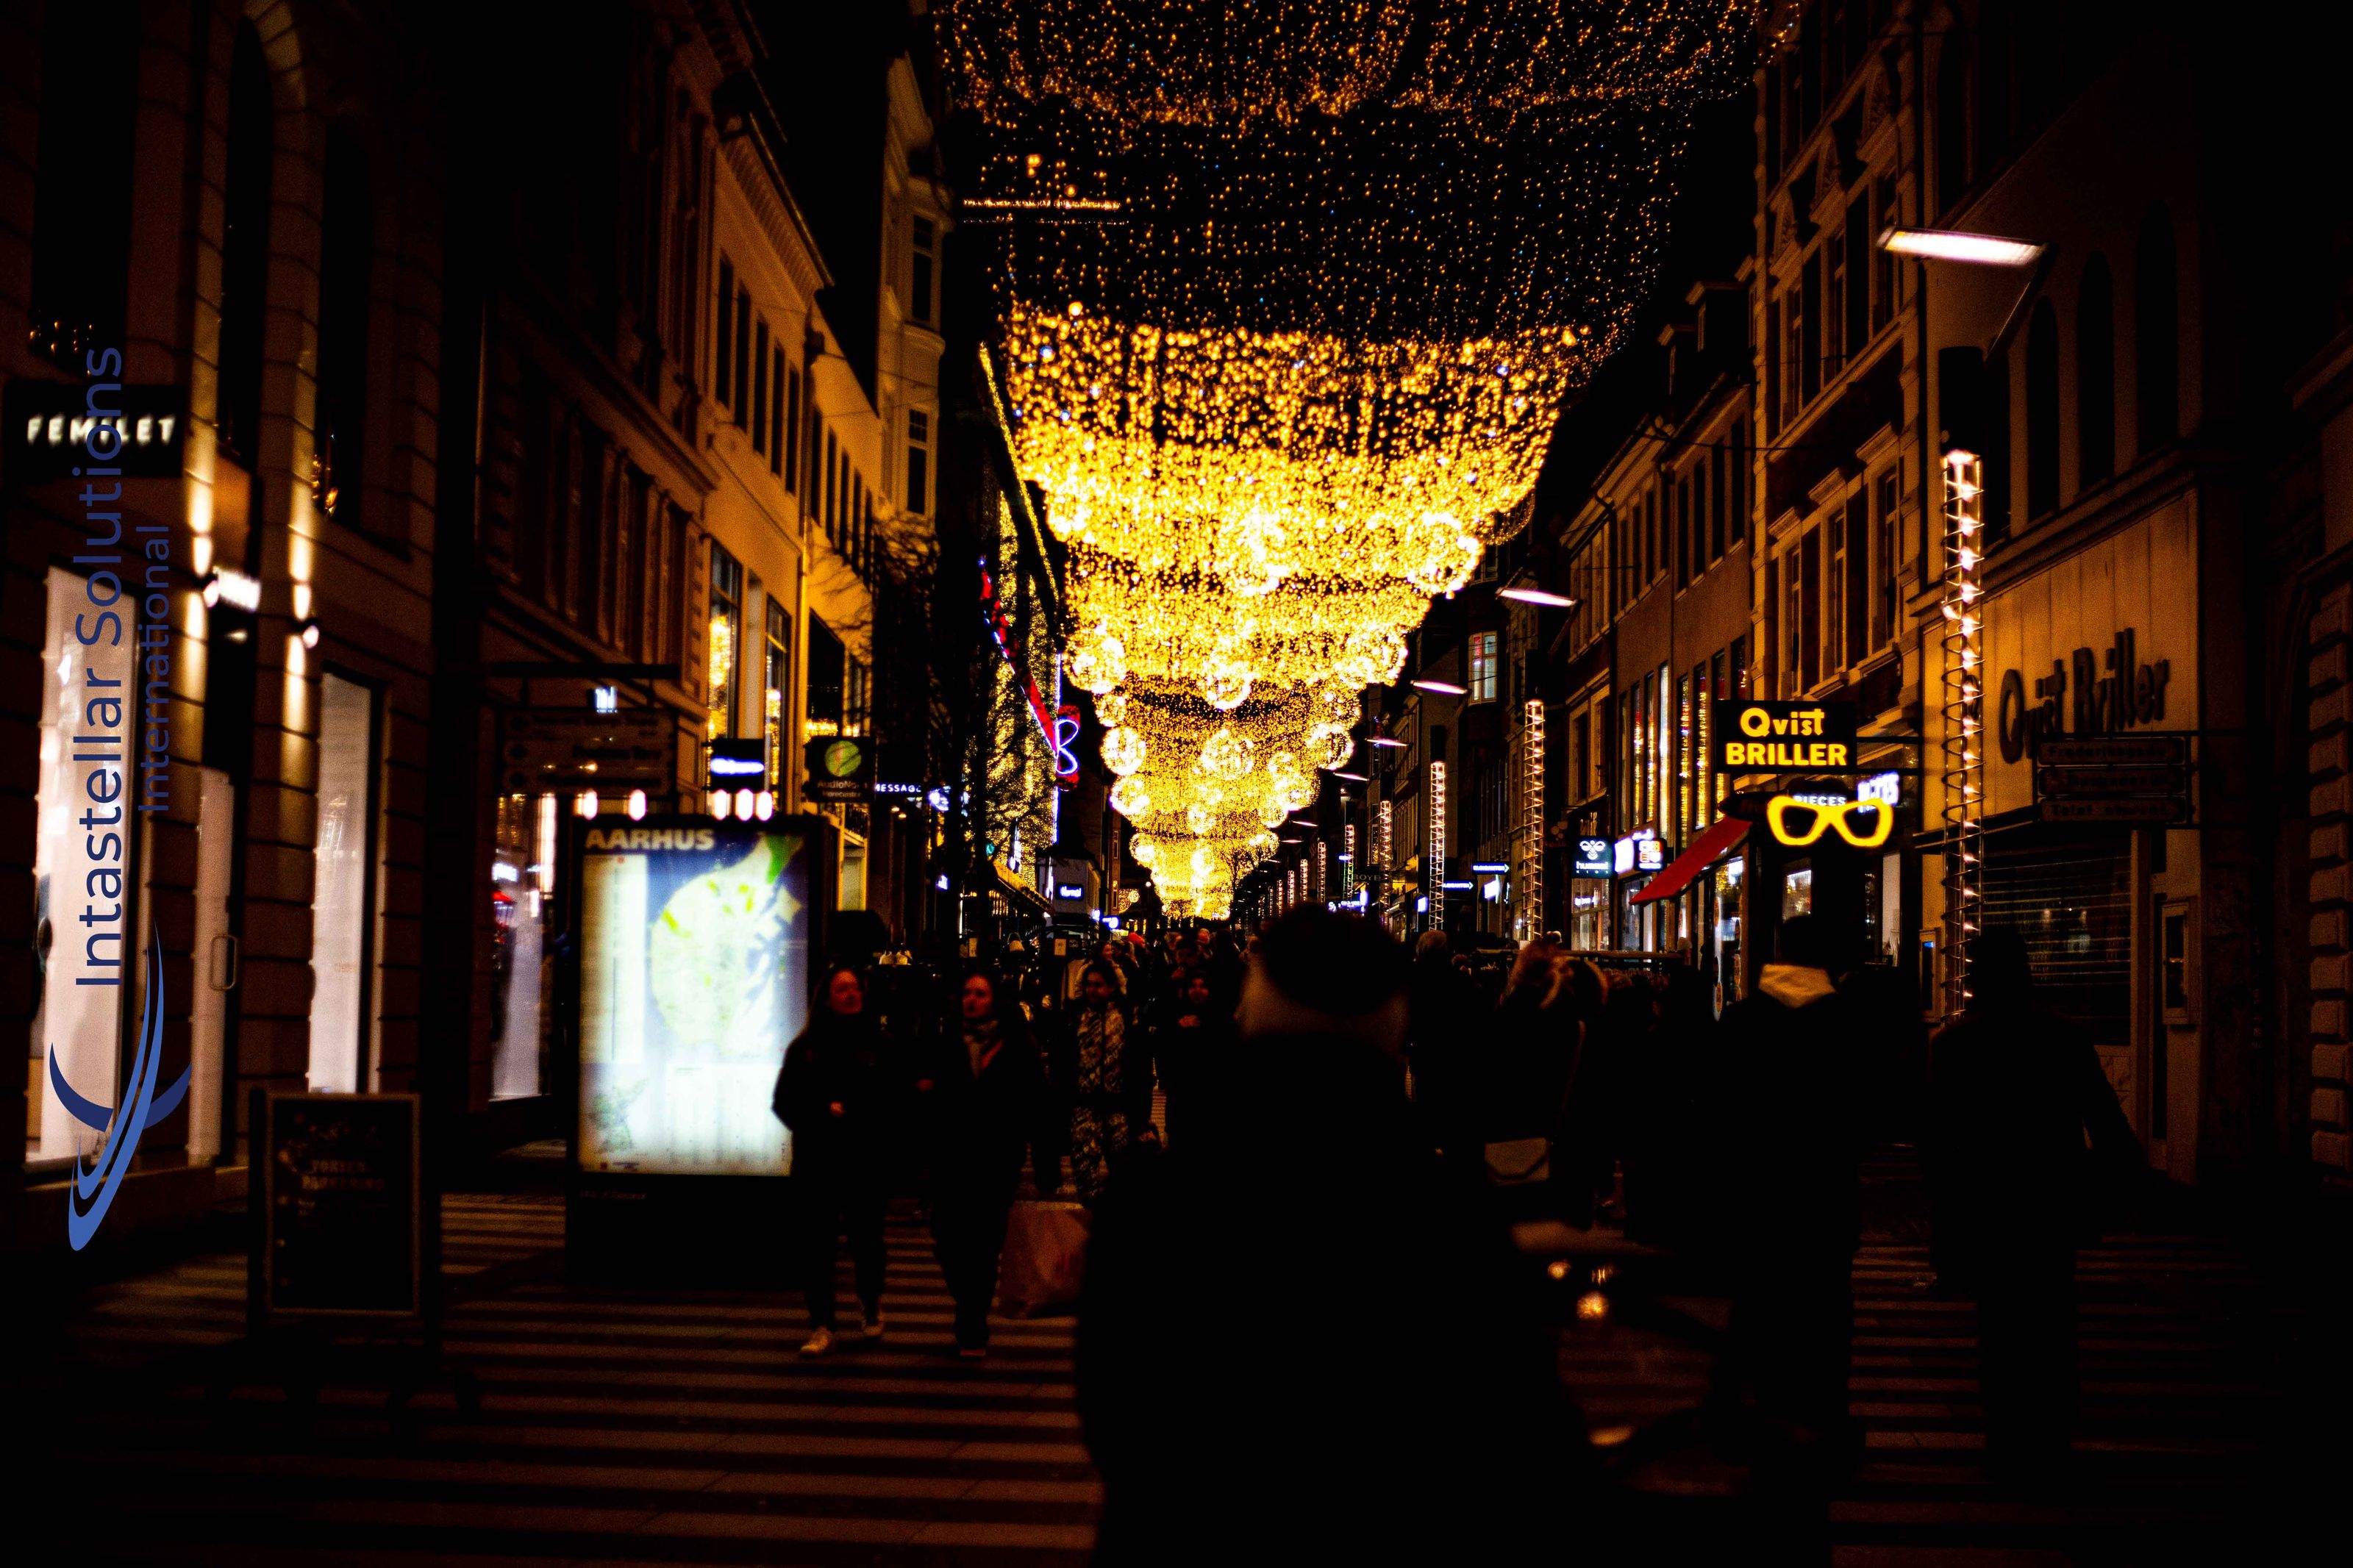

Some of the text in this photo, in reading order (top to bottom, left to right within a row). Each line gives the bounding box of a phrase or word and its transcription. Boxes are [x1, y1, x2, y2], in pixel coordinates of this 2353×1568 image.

[2073, 627, 2170, 734] Briller
[1739, 706, 1826, 737] Qvist
[1725, 742, 1848, 766] BRILLER
[1793, 795, 1846, 806] PIECES
[584, 828, 715, 851] AARHUS
